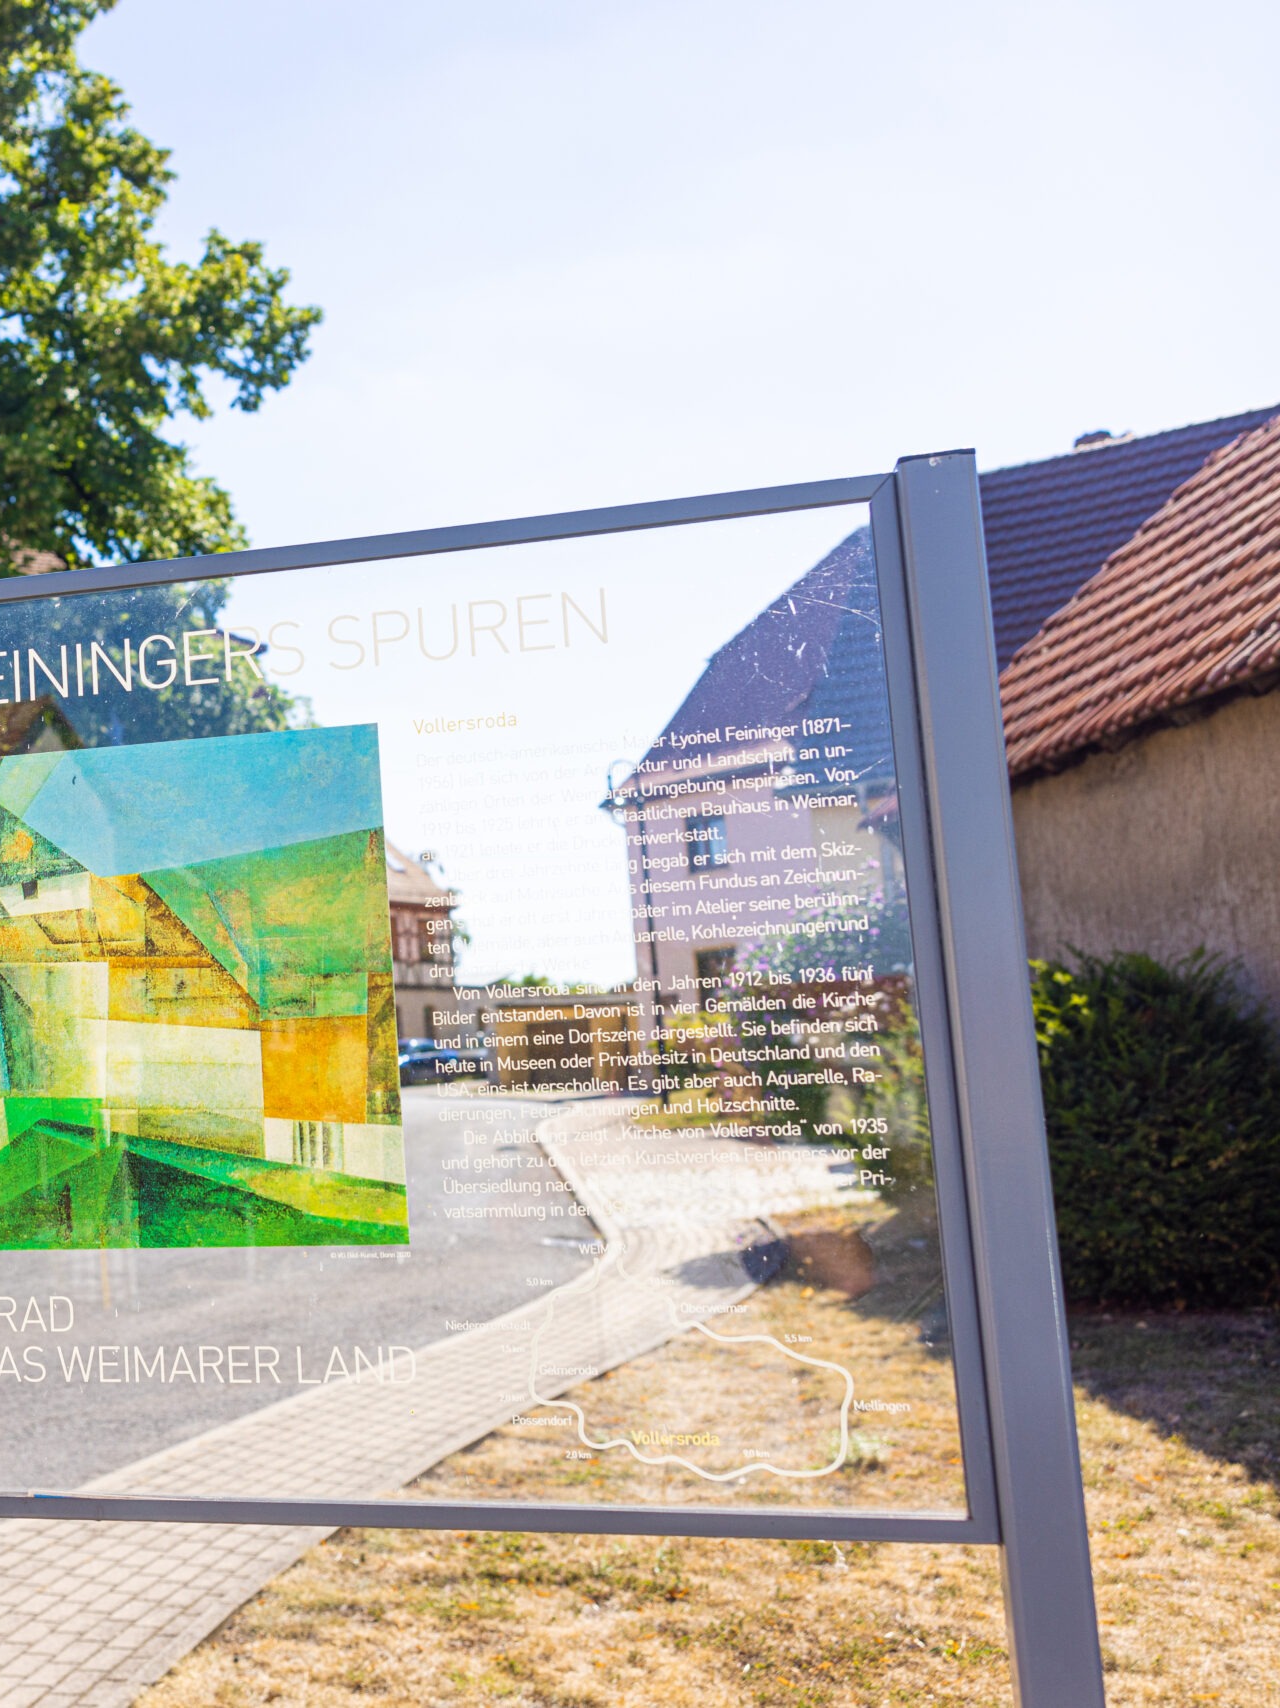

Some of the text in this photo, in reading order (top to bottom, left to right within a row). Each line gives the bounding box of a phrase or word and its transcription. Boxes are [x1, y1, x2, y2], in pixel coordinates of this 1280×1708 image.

[327, 587, 608, 670] SPUREN
[412, 711, 518, 735] Vollersroda
[671, 727, 721, 749] Lyonel
[725, 723, 797, 743] Feininger
[673, 757, 702, 771] und
[707, 746, 795, 767] Landschaft
[799, 746, 820, 760] an
[825, 743, 853, 758] un-
[641, 778, 726, 798] Umgebung
[731, 773, 819, 793] inspirieren.
[824, 767, 855, 782] Von
[613, 803, 697, 822] Staatlichen
[702, 797, 770, 817] Bauhaus
[774, 796, 789, 811] in
[792, 793, 857, 809] Weimar,
[643, 852, 688, 872] begab
[693, 853, 710, 866] er
[714, 848, 745, 864] sich
[750, 846, 776, 862] mit
[781, 844, 816, 860] dem
[821, 841, 861, 857] Skiz-
[640, 878, 695, 894] diesem
[700, 873, 757, 890] Fundus
[761, 873, 780, 886] an
[784, 866, 864, 884] Zeichnun-
[426, 918, 453, 935] gen
[626, 904, 669, 922] päter
[672, 901, 692, 916] im
[695, 897, 746, 915] Atelier
[749, 897, 791, 912] seine
[795, 893, 866, 909] berühm-
[427, 941, 451, 955] ten
[692, 918, 835, 940] Kohlezeichnungen
[838, 915, 869, 931] und
[453, 987, 480, 1001] Von
[486, 981, 570, 999] Vollersroda
[632, 977, 661, 992] den
[667, 974, 722, 991] Jahren
[728, 971, 763, 987] 1912
[769, 969, 792, 985] bis
[799, 967, 836, 983] 1936
[841, 964, 874, 982] fünf
[432, 990, 876, 1026] Bilder entstanden. Davon ist in vier Gemälden die Kirche
[433, 1016, 878, 1050] und in einem eine Dorfszene dargestellt. Sie befinden sich
[435, 1041, 881, 1074] heute in Museen oder Privatbesitz in Deutschland und den
[436, 1067, 883, 1099] USA, eins ist verschollen. Es gibt aber auch Aquarelle, Ra-
[663, 1099, 693, 1115] und
[697, 1096, 800, 1114] Holzschnitte.
[463, 1130, 487, 1145] Die
[573, 1127, 608, 1144] zeigt
[677, 1126, 705, 1140] von
[812, 1123, 843, 1136] von
[851, 1117, 888, 1135] 1935
[441, 1155, 469, 1170] und
[473, 1154, 522, 1174] gehört
[526, 1156, 543, 1168] zu
[580, 1151, 631, 1166] letzten
[635, 1149, 739, 1165] Kunstwerken
[743, 1146, 828, 1163] Feiningers
[832, 1147, 859, 1161] vor
[862, 1144, 891, 1160] der
[443, 1176, 542, 1197] Übersiedlung
[860, 1169, 892, 1186] Pri-
[443, 1203, 545, 1222] vatsammlung
[550, 1202, 564, 1217] in
[539, 1277, 553, 1286] km
[680, 1302, 749, 1314] Oberweimar
[799, 1333, 813, 1343] km
[57, 1345, 281, 1383] WEIMARER
[296, 1345, 417, 1384] LAND
[538, 1363, 599, 1376] Gelmeroda
[511, 1414, 573, 1427] Possendorf
[853, 1399, 911, 1415] Mellingen
[631, 1429, 720, 1447] Vollersroda
[578, 1450, 592, 1460] km
